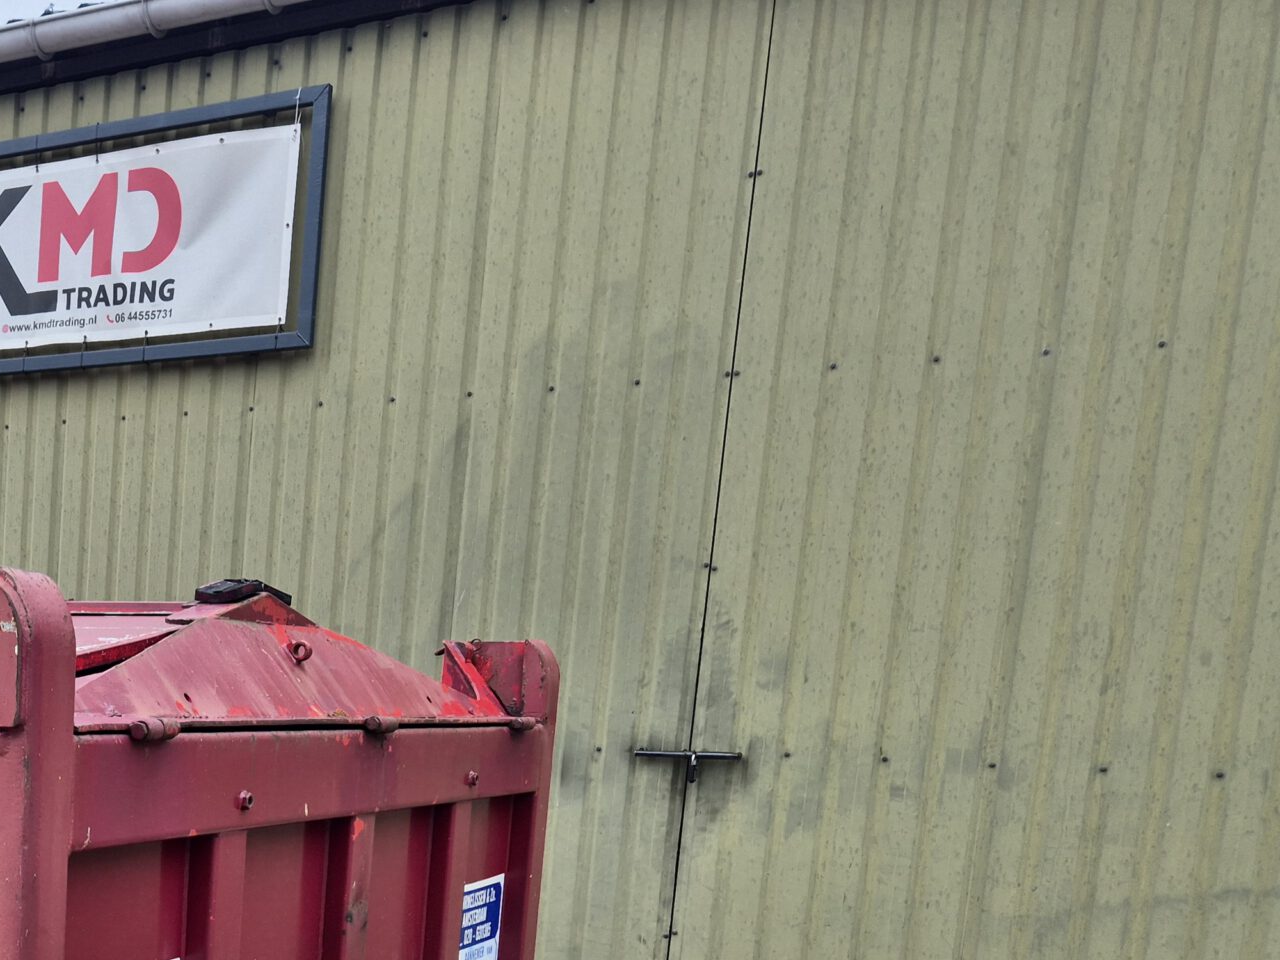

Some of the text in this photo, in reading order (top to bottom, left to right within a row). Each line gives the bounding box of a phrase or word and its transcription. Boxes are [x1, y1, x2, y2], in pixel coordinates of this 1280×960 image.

[62, 279, 175, 310] TRADING
[114, 313, 125, 323] 06
[127, 309, 173, 321] 44555731
